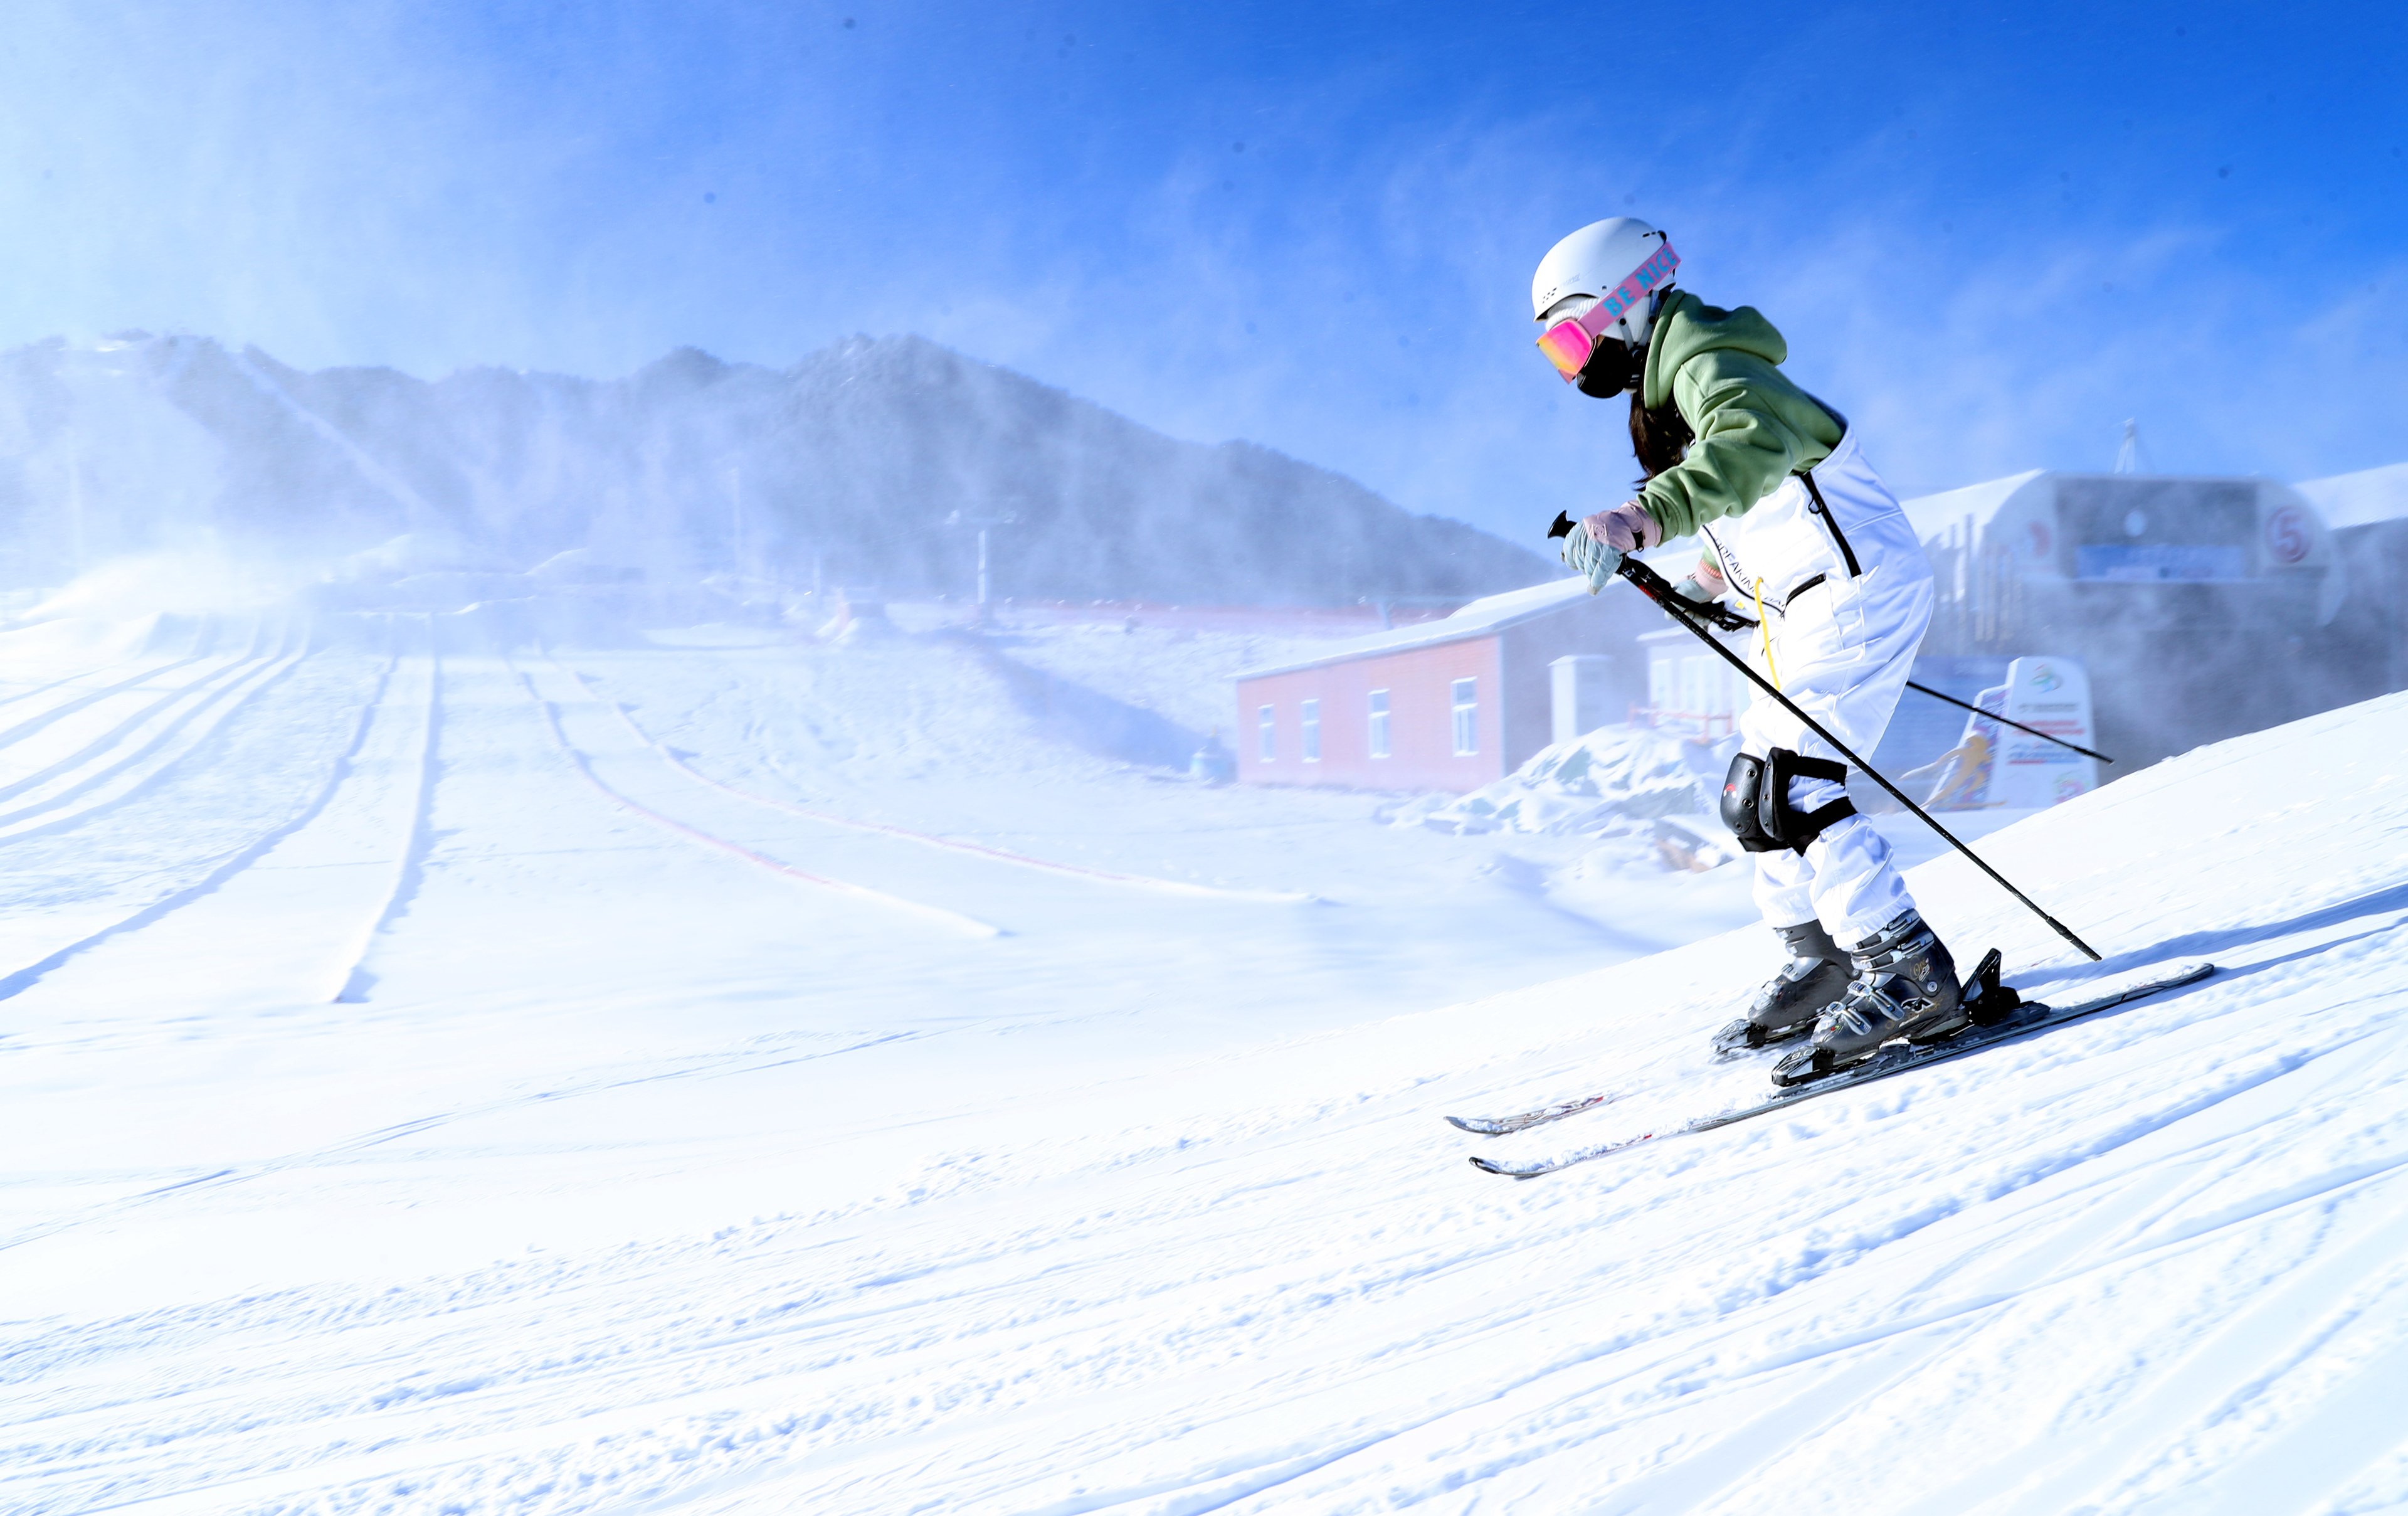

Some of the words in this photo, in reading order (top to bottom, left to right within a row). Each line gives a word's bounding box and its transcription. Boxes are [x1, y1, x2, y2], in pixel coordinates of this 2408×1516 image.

[1603, 287, 1635, 317] BE
[1634, 248, 1677, 290] NICE
[2274, 514, 2303, 556] 5
